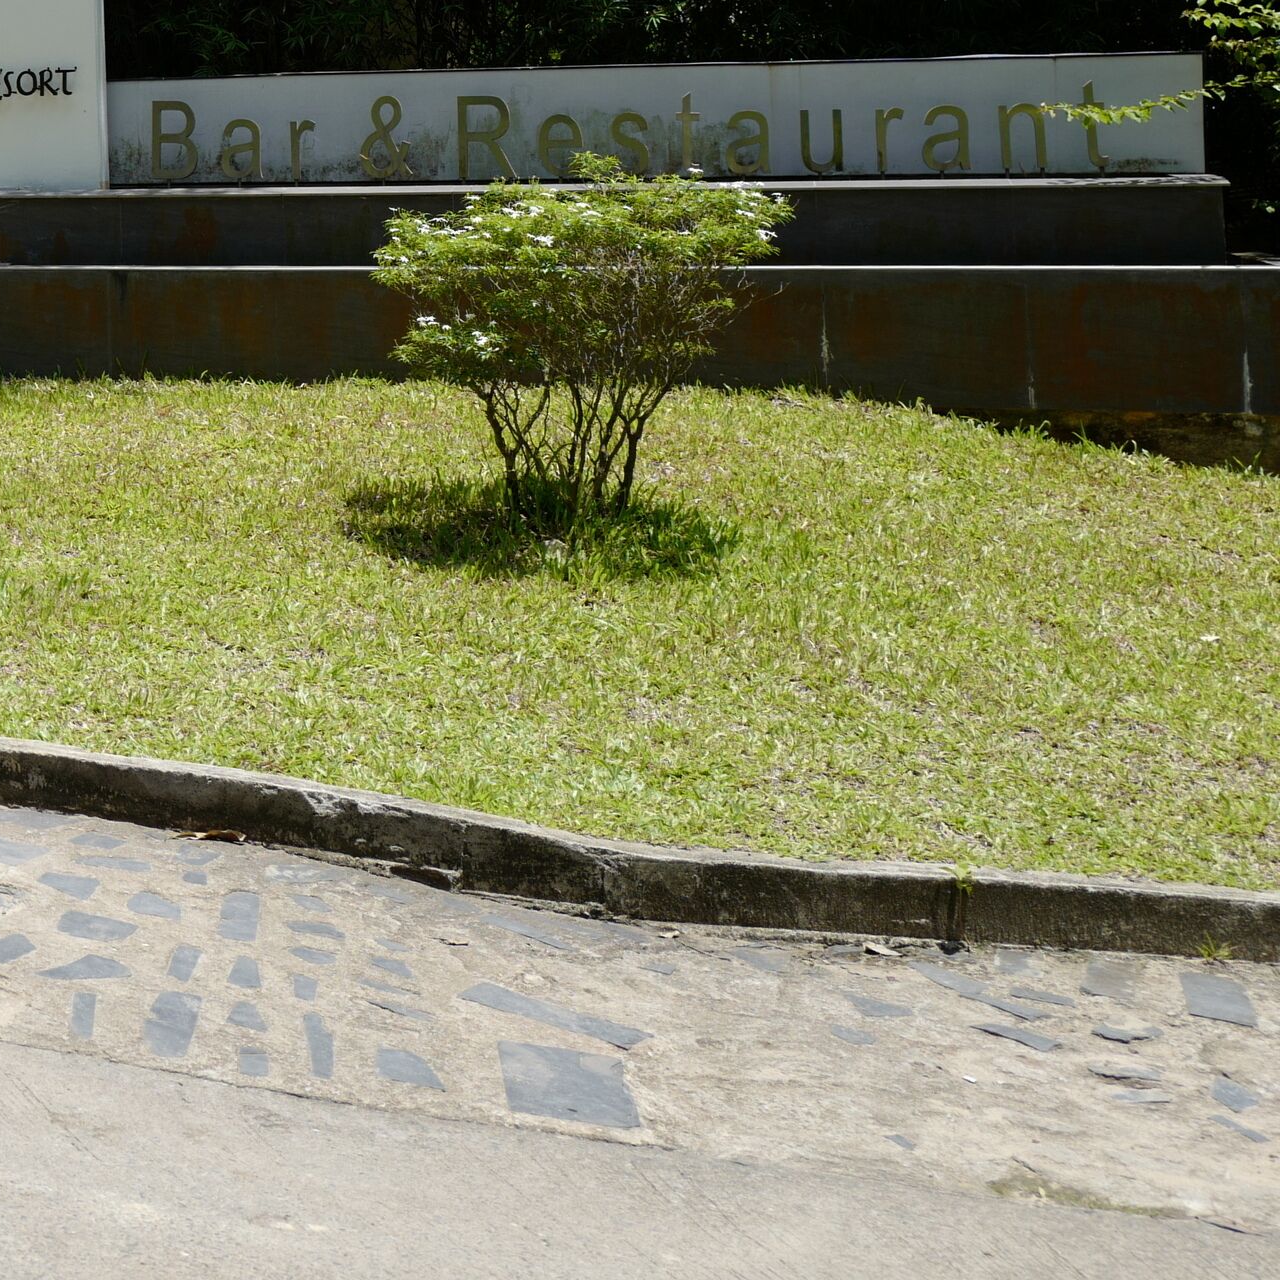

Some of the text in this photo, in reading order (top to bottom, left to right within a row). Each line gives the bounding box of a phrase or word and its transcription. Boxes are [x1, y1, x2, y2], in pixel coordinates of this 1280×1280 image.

[151, 79, 1110, 180] Bar & Restaurant
